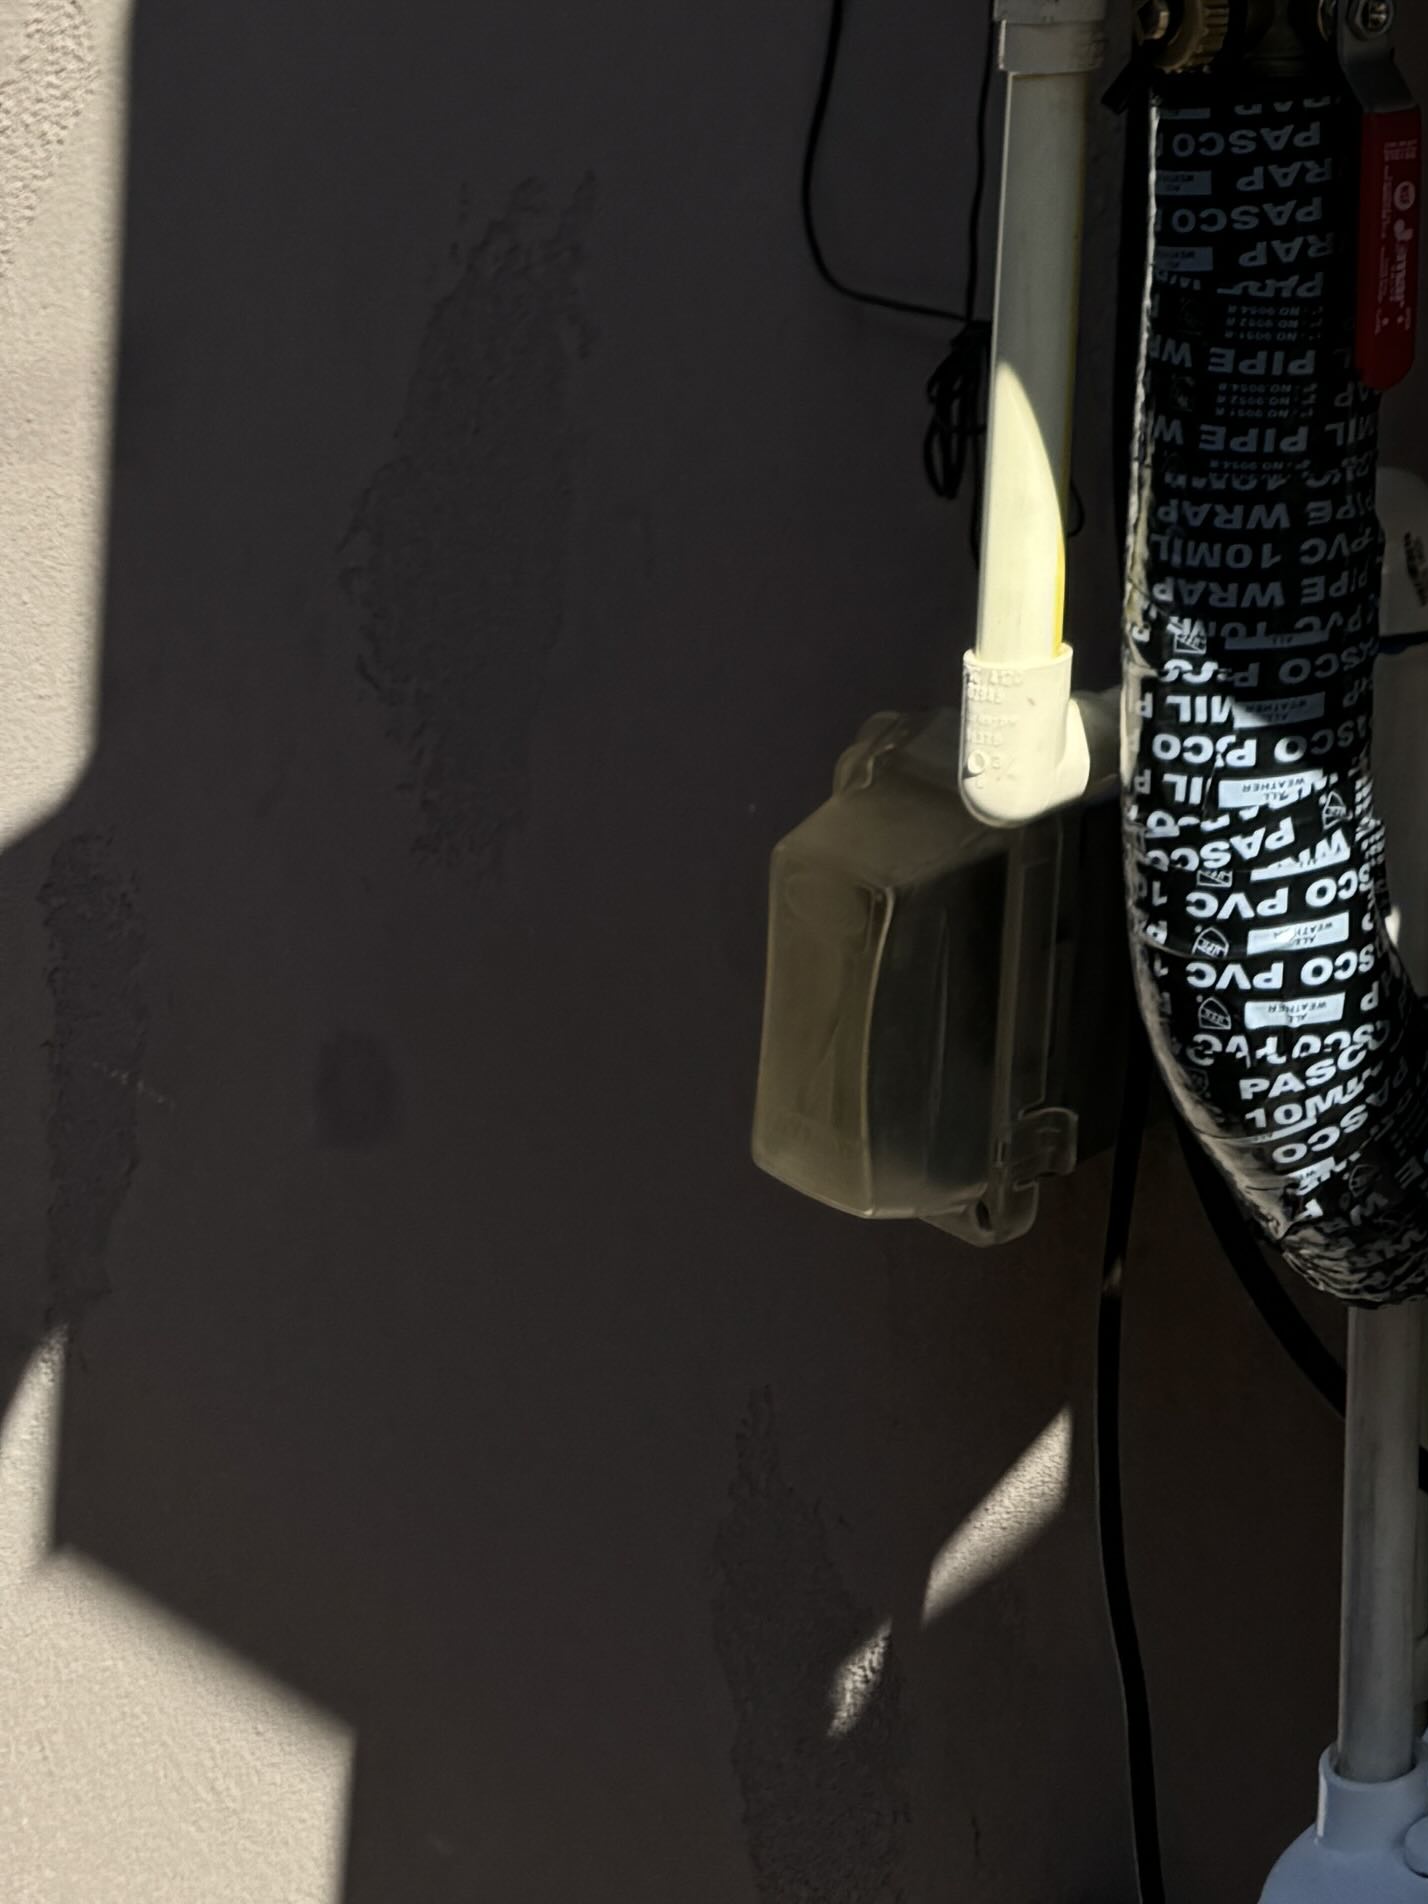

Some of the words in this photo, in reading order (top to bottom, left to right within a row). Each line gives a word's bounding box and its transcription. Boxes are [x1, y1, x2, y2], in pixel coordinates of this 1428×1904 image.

[1172, 120, 1322, 159] PASCO
[1171, 195, 1323, 233] PASCO
[1208, 347, 1317, 377] PIPE
[1199, 425, 1311, 454] PIPE
[1156, 498, 1292, 531] WRAP
[1151, 535, 1284, 571] 10MIL
[1300, 526, 1376, 567] PVC
[1150, 580, 1286, 610] WRAP
[1185, 888, 1289, 921] PVC
[1185, 961, 1285, 991] PVC
